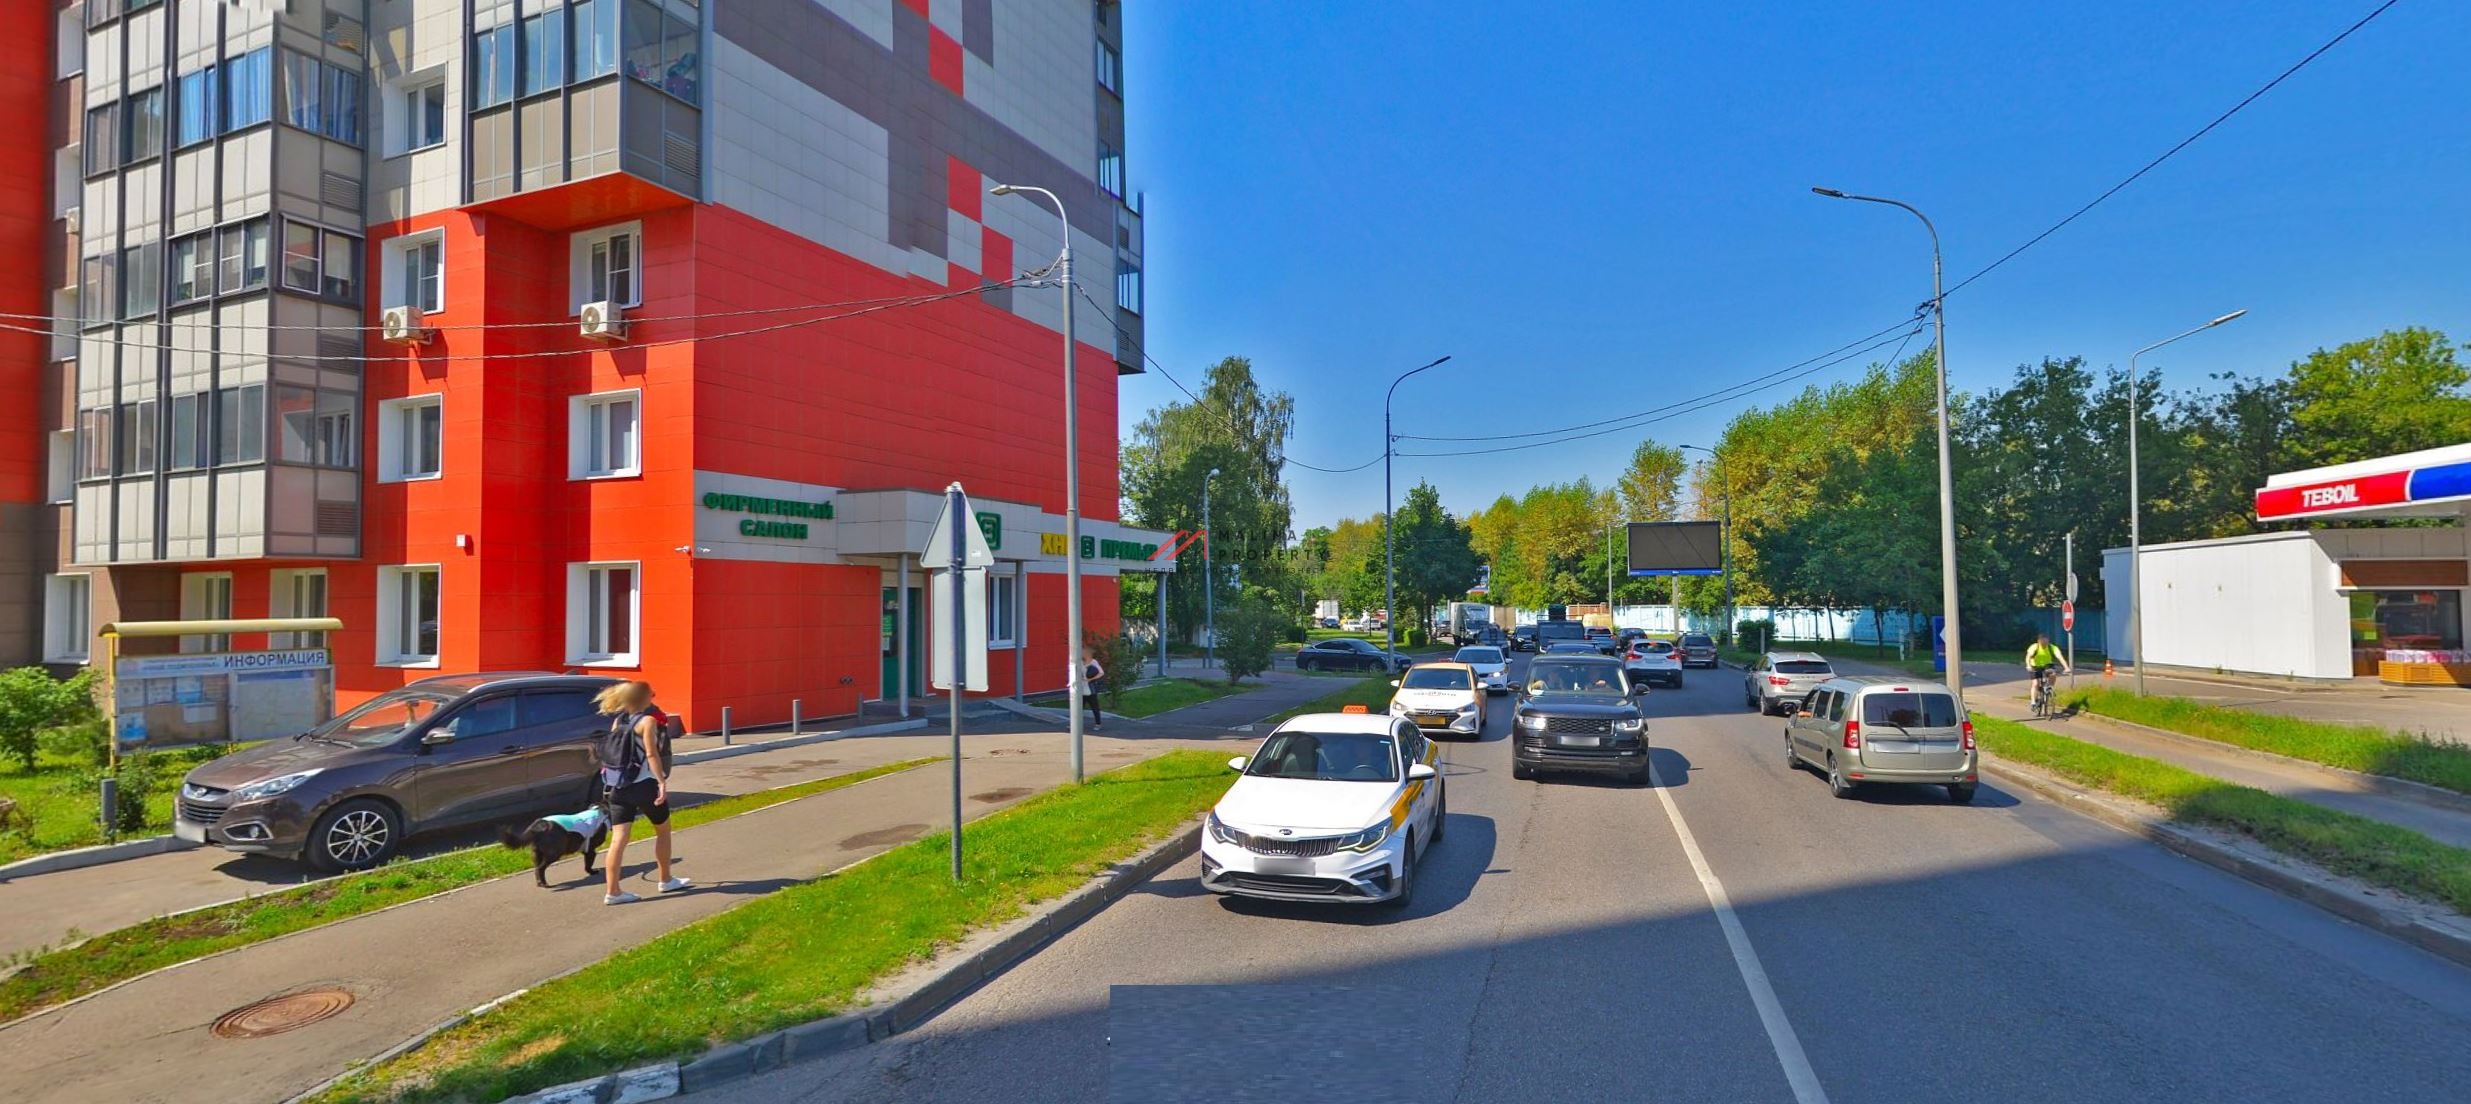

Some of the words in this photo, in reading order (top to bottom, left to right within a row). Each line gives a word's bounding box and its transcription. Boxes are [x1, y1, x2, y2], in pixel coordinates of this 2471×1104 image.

[703, 492, 833, 520] ФИРМЕННЫЙ
[2301, 484, 2360, 507] TEBOIL
[740, 519, 808, 539] САЛОН
[224, 651, 325, 668] ИНФОРМАЦИЯ
